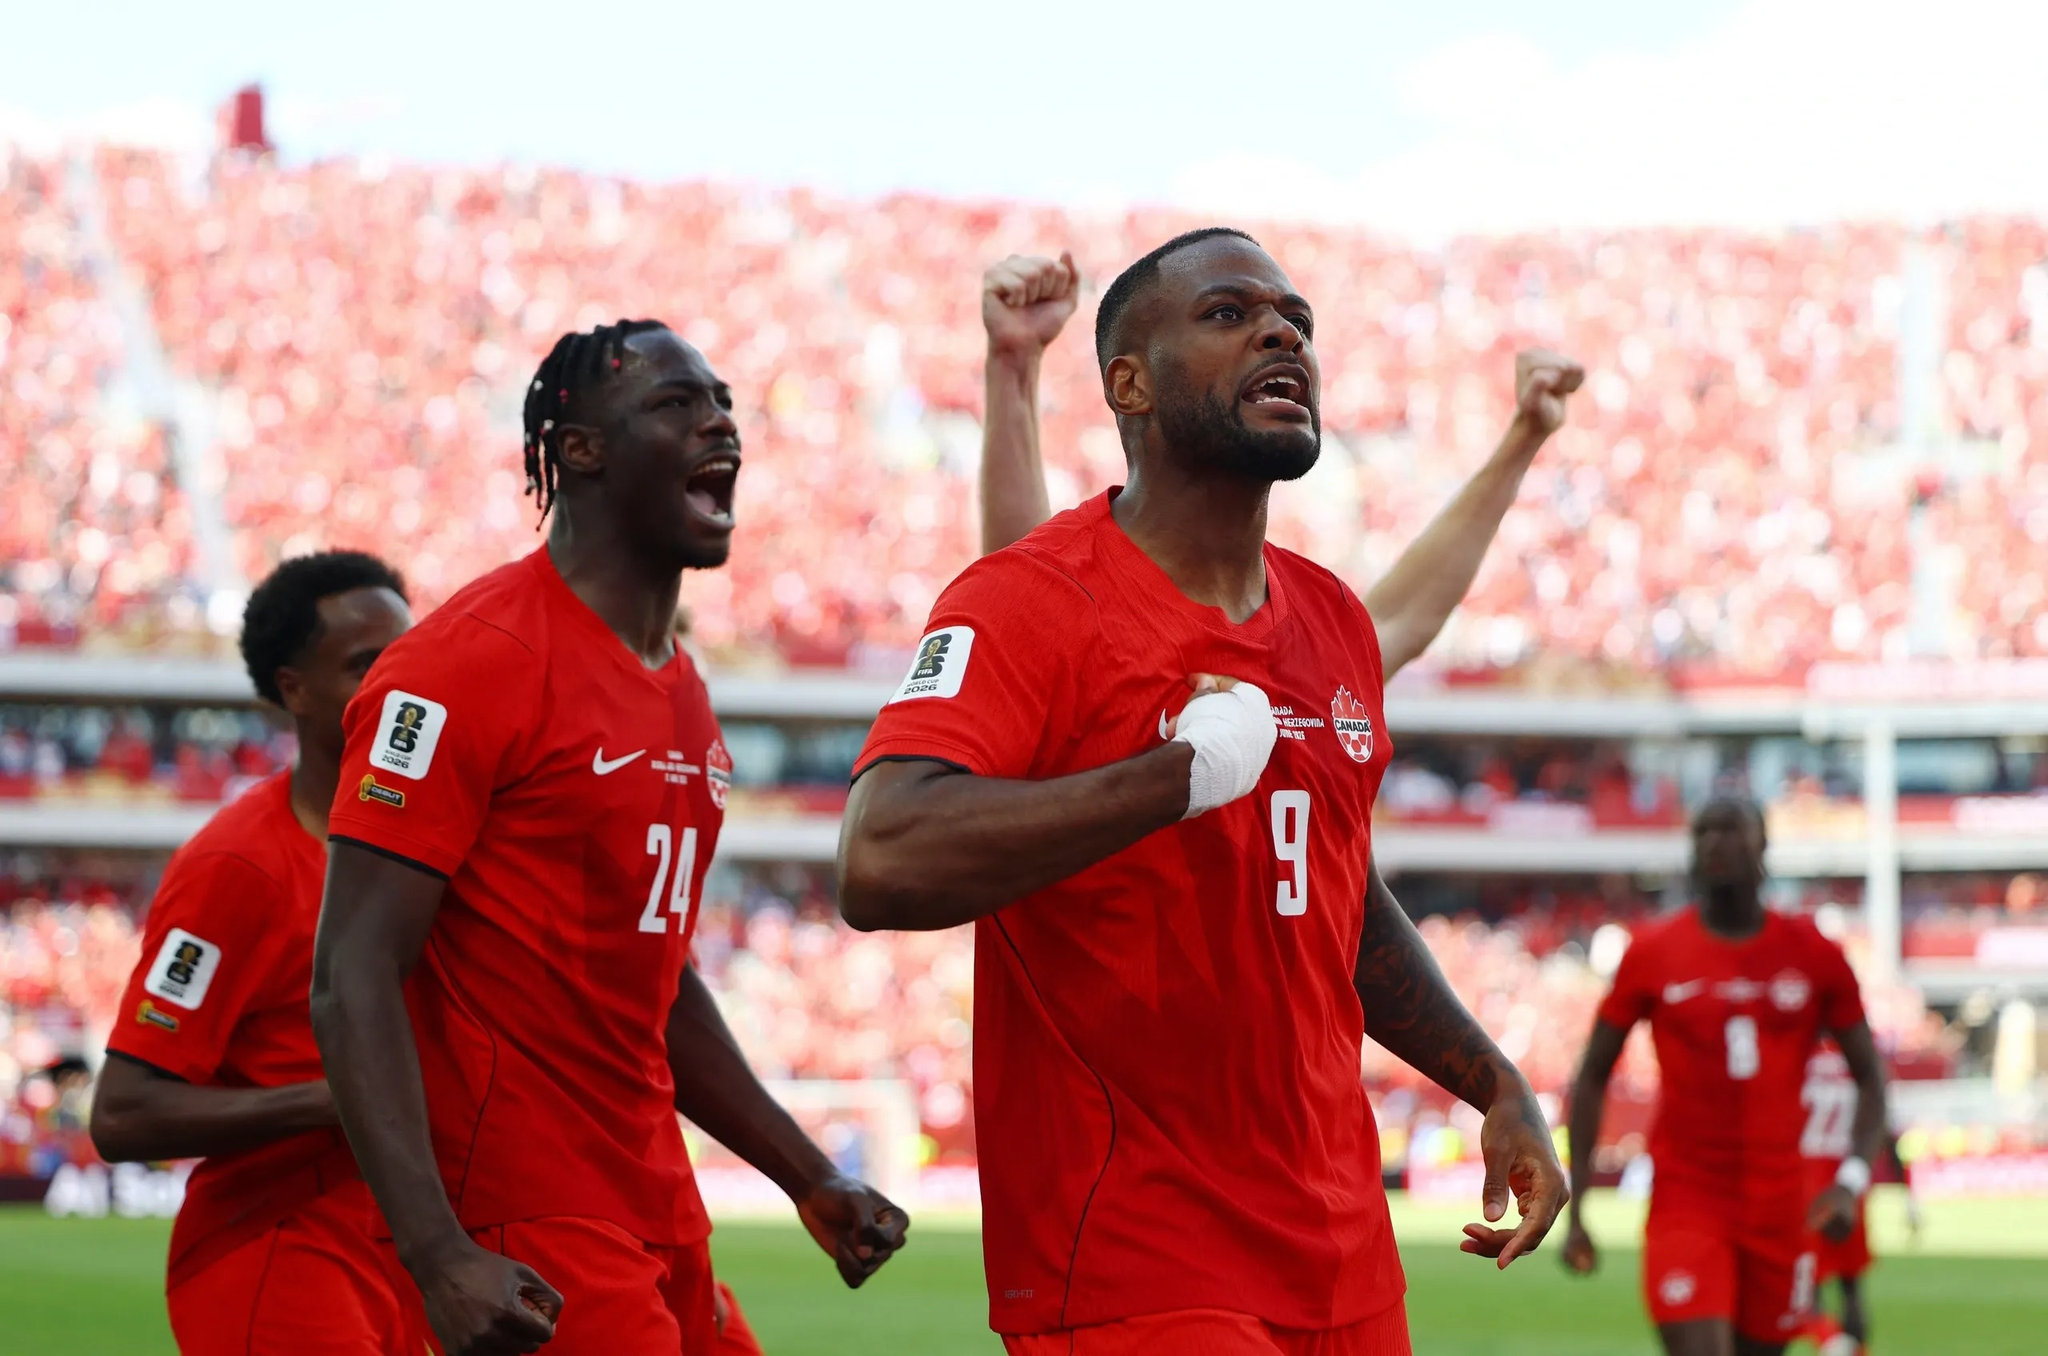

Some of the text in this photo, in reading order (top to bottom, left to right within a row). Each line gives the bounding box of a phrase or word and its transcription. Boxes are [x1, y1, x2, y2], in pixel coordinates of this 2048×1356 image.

[917, 668, 933, 676] FIFA
[904, 684, 937, 694] 2026
[1271, 706, 1294, 716] ANADA
[1335, 719, 1371, 733] CANADA
[381, 754, 410, 769] 2026
[370, 785, 401, 800] DEBUT
[1271, 789, 1311, 916] 9
[638, 823, 698, 935] 24
